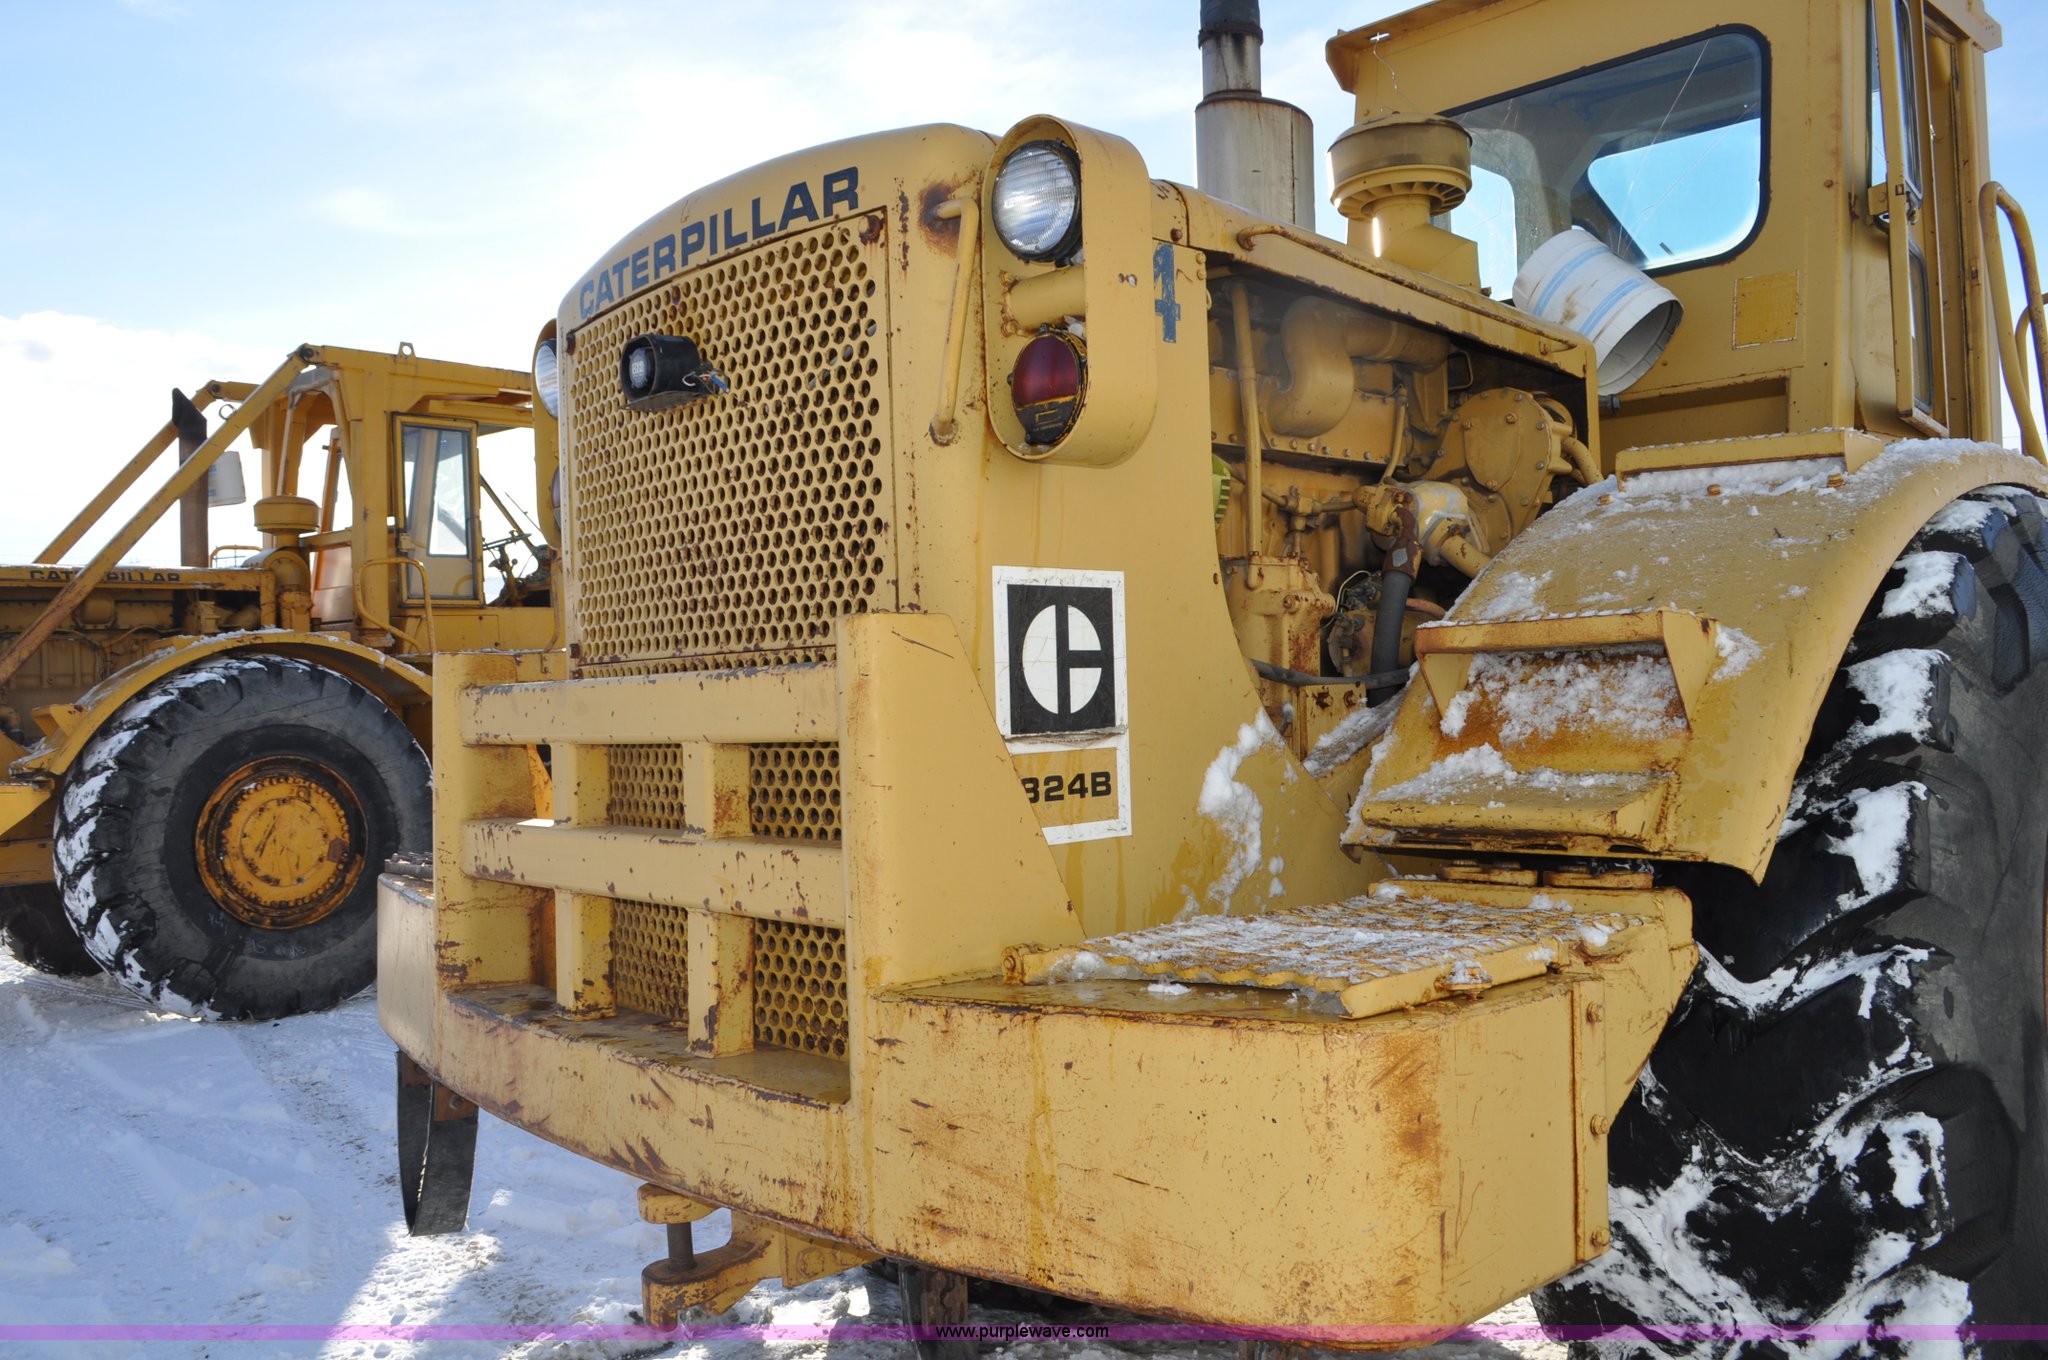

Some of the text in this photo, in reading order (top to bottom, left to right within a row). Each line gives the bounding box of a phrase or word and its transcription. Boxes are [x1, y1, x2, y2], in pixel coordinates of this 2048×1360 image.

[579, 165, 859, 320] CATERPILLAR
[29, 569, 181, 583] CATPILLAR
[1020, 770, 1113, 805] 824B
